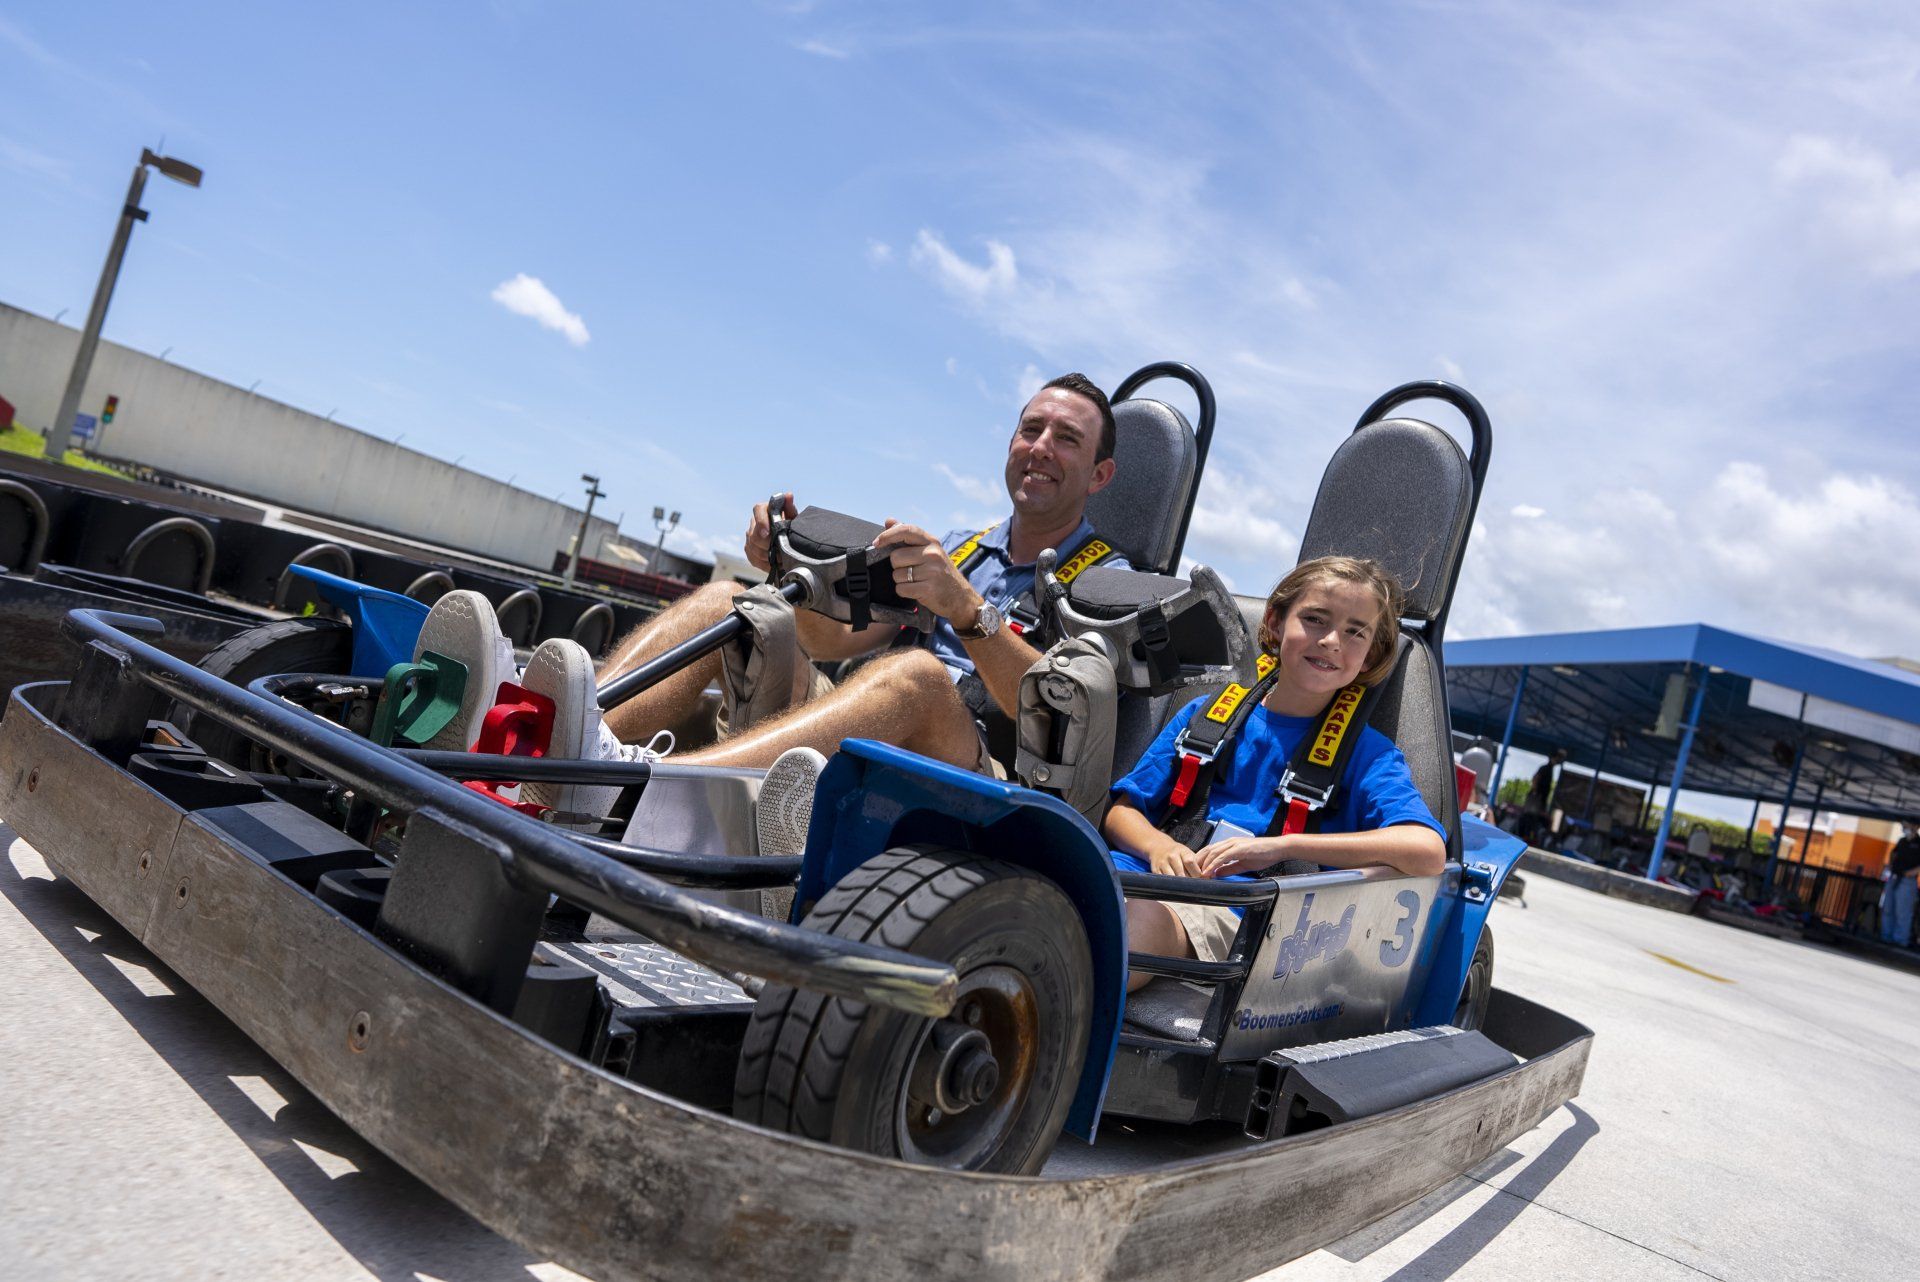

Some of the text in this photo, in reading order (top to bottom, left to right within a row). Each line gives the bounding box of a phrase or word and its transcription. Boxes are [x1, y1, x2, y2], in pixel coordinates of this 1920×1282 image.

[1055, 542, 1106, 582] GOKAR
[1313, 685, 1361, 762] GOKARTS
[1379, 889, 1421, 968] 3
[1239, 1004, 1340, 1030] BoomersParks.com
